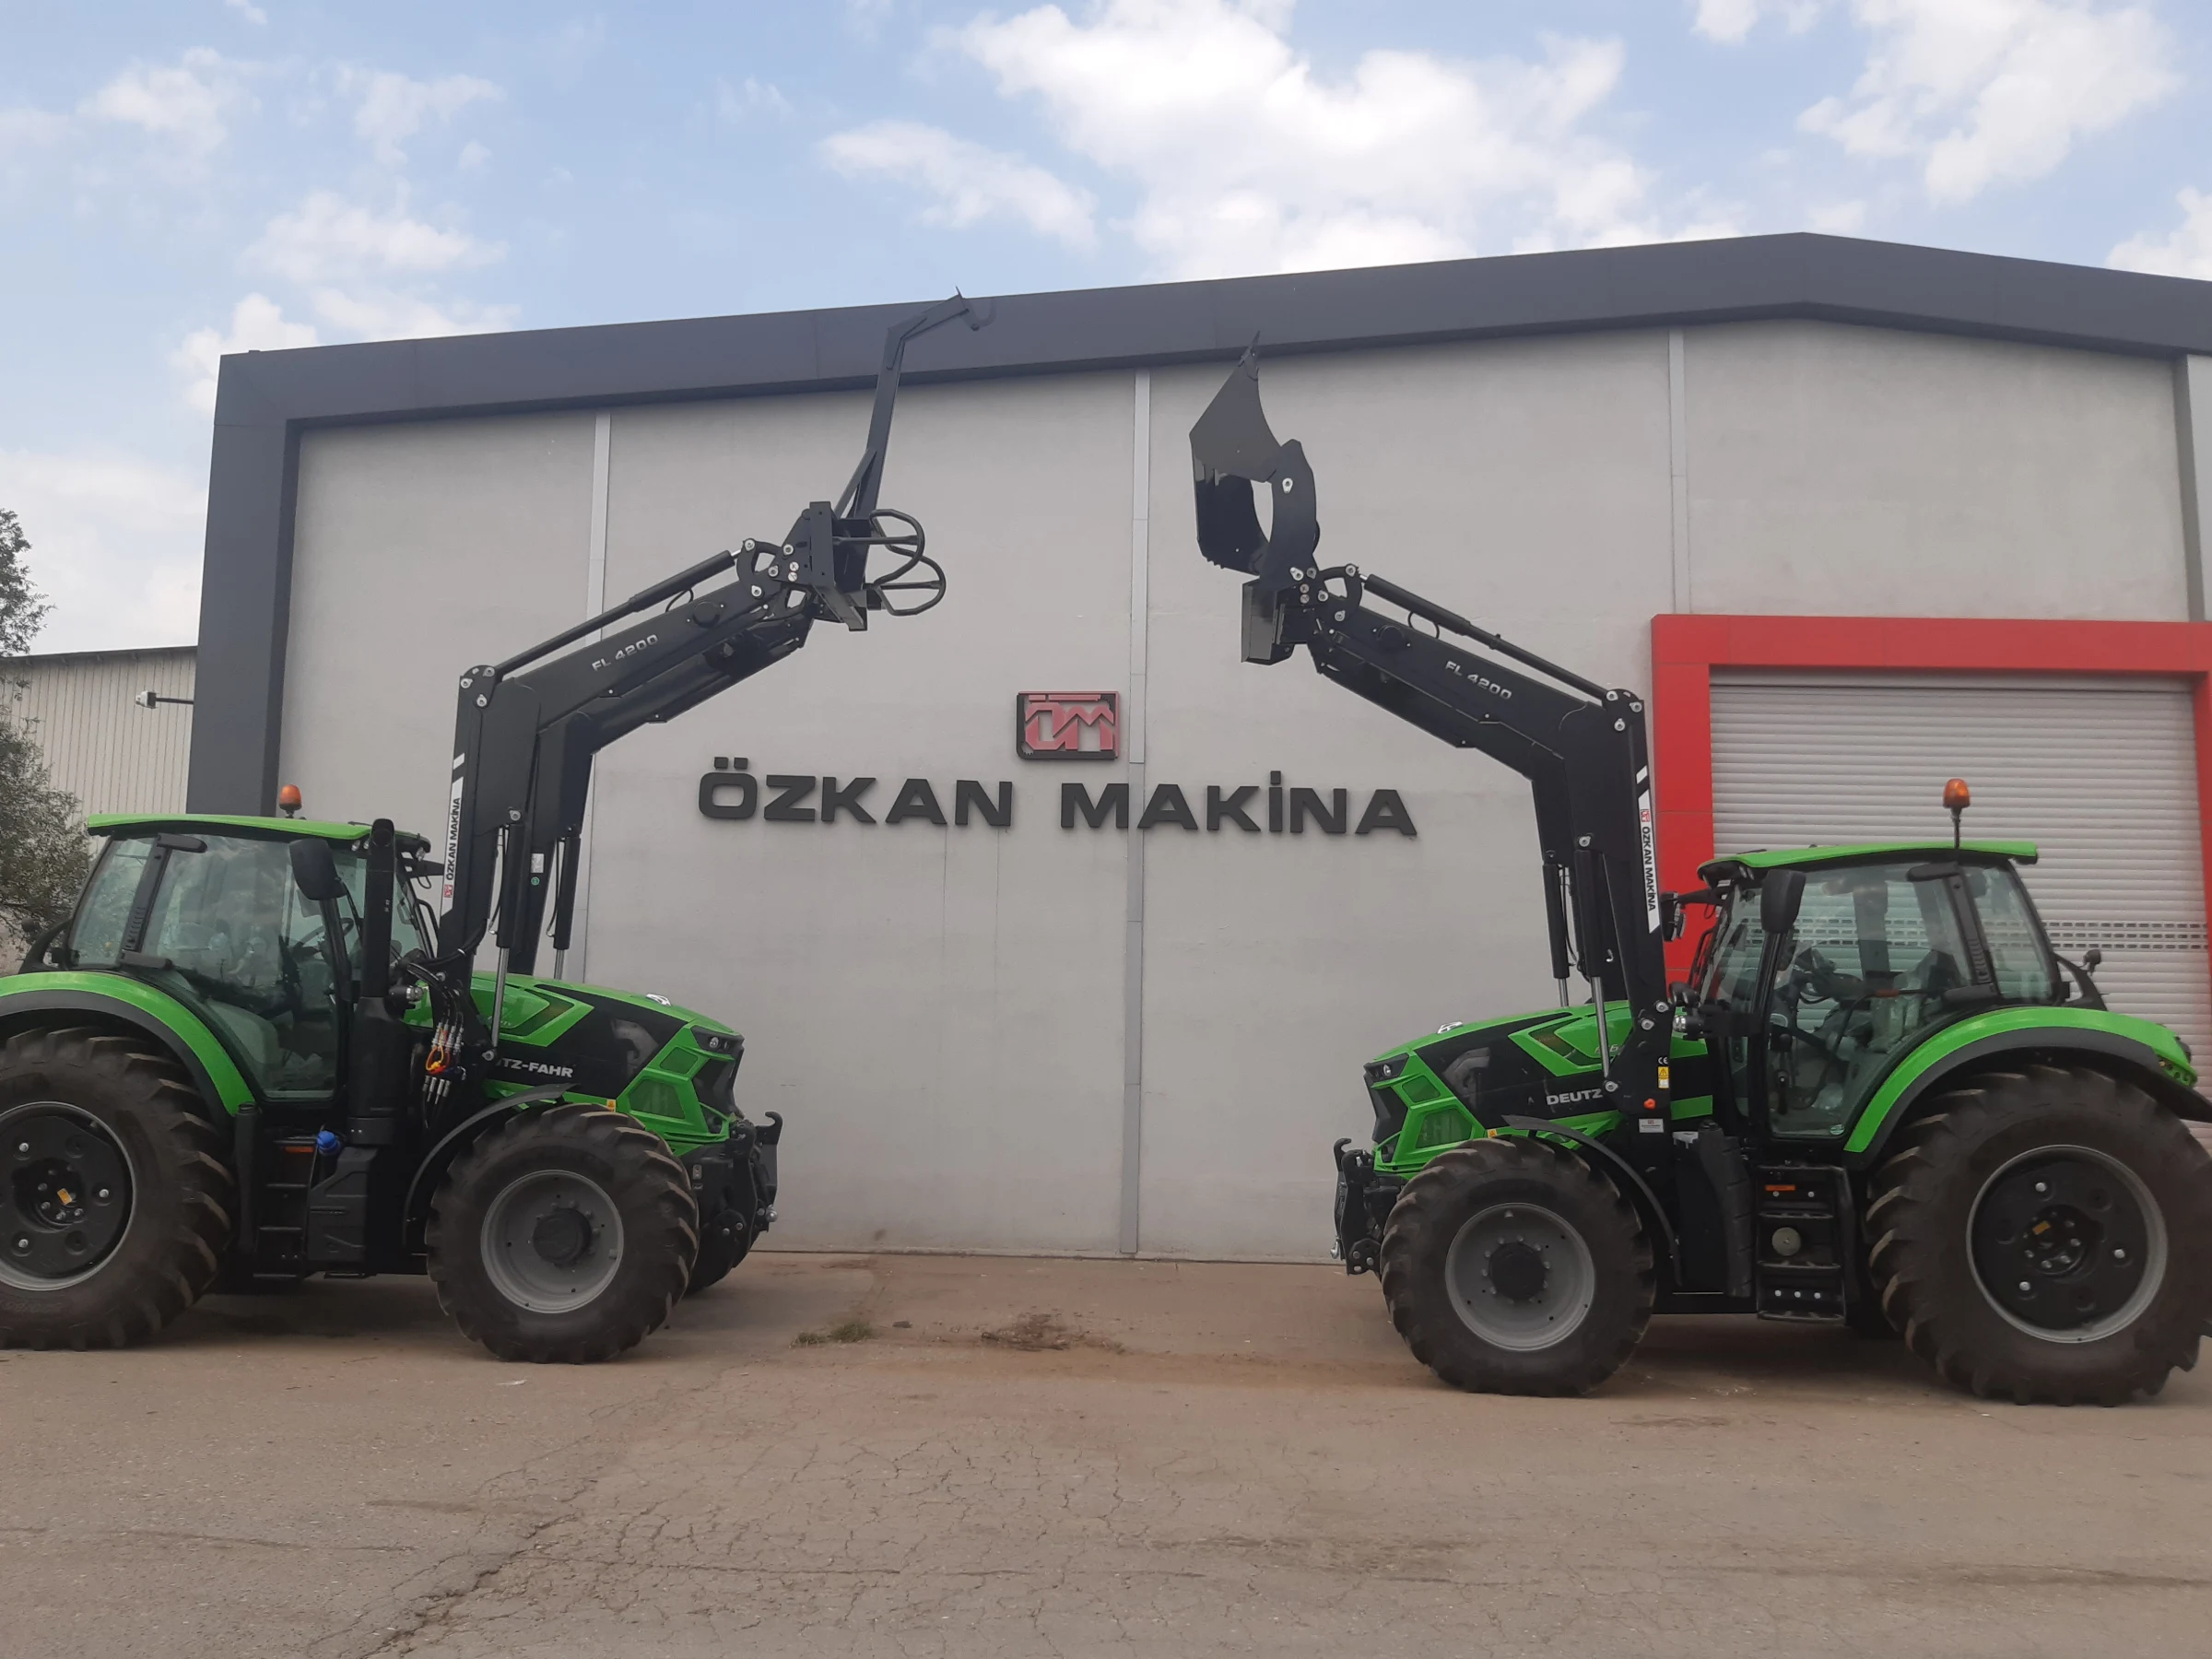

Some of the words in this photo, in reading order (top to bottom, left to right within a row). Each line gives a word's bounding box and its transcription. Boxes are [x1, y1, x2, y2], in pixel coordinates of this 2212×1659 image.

[591, 658, 612, 672] FL
[615, 634, 658, 660] 4200
[1445, 660, 1463, 677] FL
[1467, 674, 1512, 700] 4200
[698, 757, 1013, 827] ÖZKAN
[1061, 771, 1418, 835] MAKİNA
[449, 797, 461, 841] MAKİNA
[446, 842, 457, 881] ÖZKAN
[1641, 826, 1653, 865] ÖZKAN
[1645, 867, 1656, 912] MAKİNA
[497, 1057, 573, 1077] TZ-FAHR
[1546, 1088, 1604, 1106] DEUTZ
